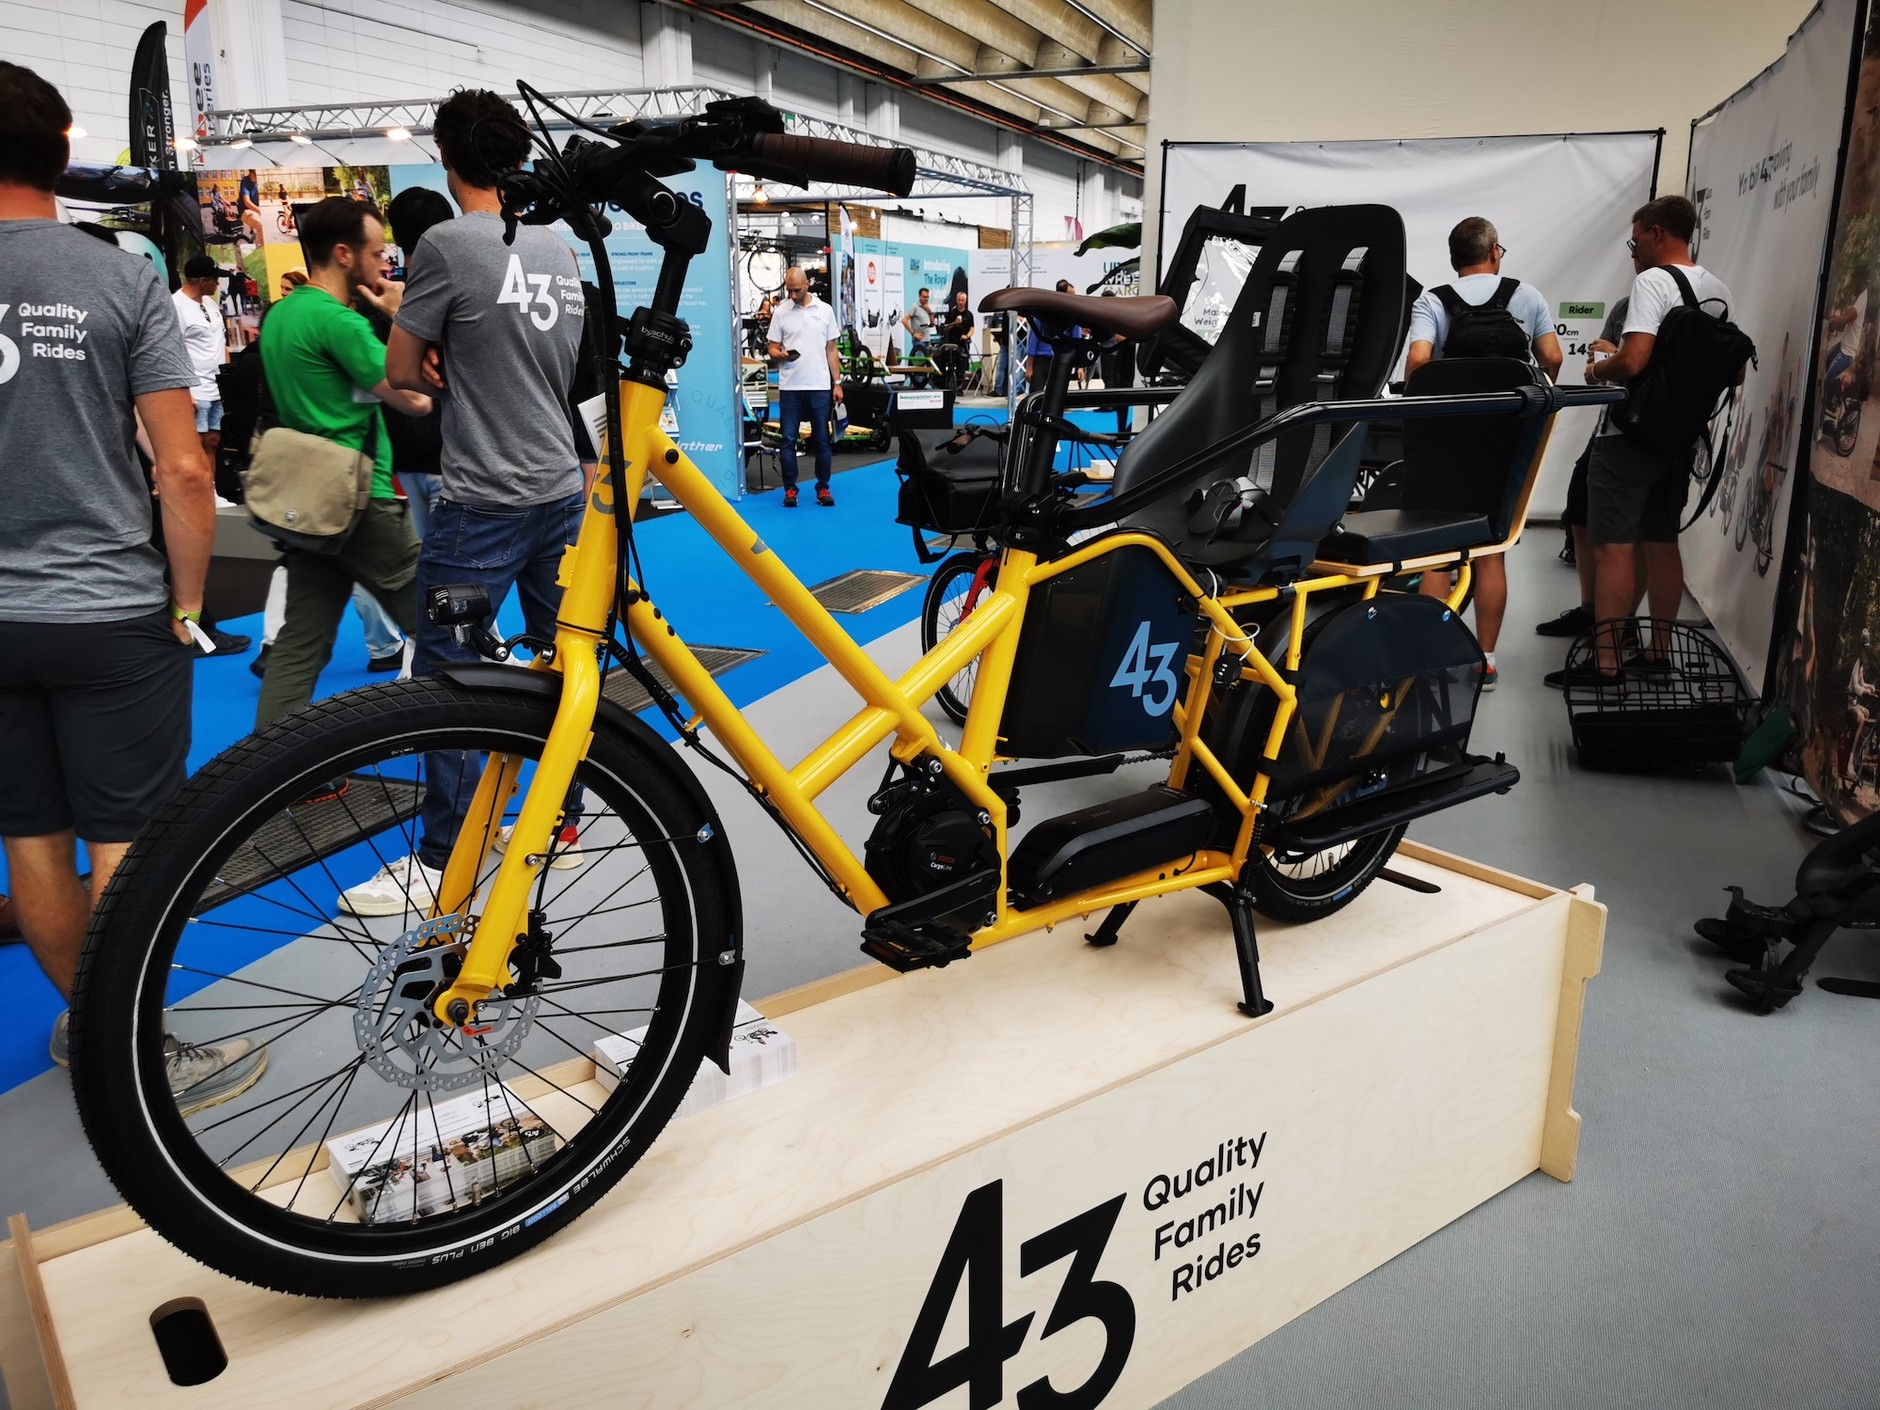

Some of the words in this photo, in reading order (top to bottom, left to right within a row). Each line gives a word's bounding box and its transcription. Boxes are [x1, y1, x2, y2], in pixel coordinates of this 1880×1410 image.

[163, 90, 176, 157] Stronger.
[147, 124, 160, 168] KER
[496, 253, 558, 331] 43
[924, 273, 935, 285] The
[934, 274, 948, 287] Royal
[19, 303, 89, 324] Quality
[1568, 305, 1595, 314] Rider
[22, 322, 88, 343] Family
[1554, 323, 1580, 336] 0cm
[33, 343, 86, 360] Rides
[677, 441, 723, 452] inther
[1108, 620, 1180, 717] 43
[572, 1136, 631, 1195] SCHWALBE
[1143, 1131, 1268, 1212] Quality
[501, 1224, 521, 1241] BIG
[1154, 1181, 1265, 1261] Family
[431, 1249, 465, 1265] PLUS
[1172, 1233, 1261, 1302] Rides
[881, 1178, 1137, 1410] 43
